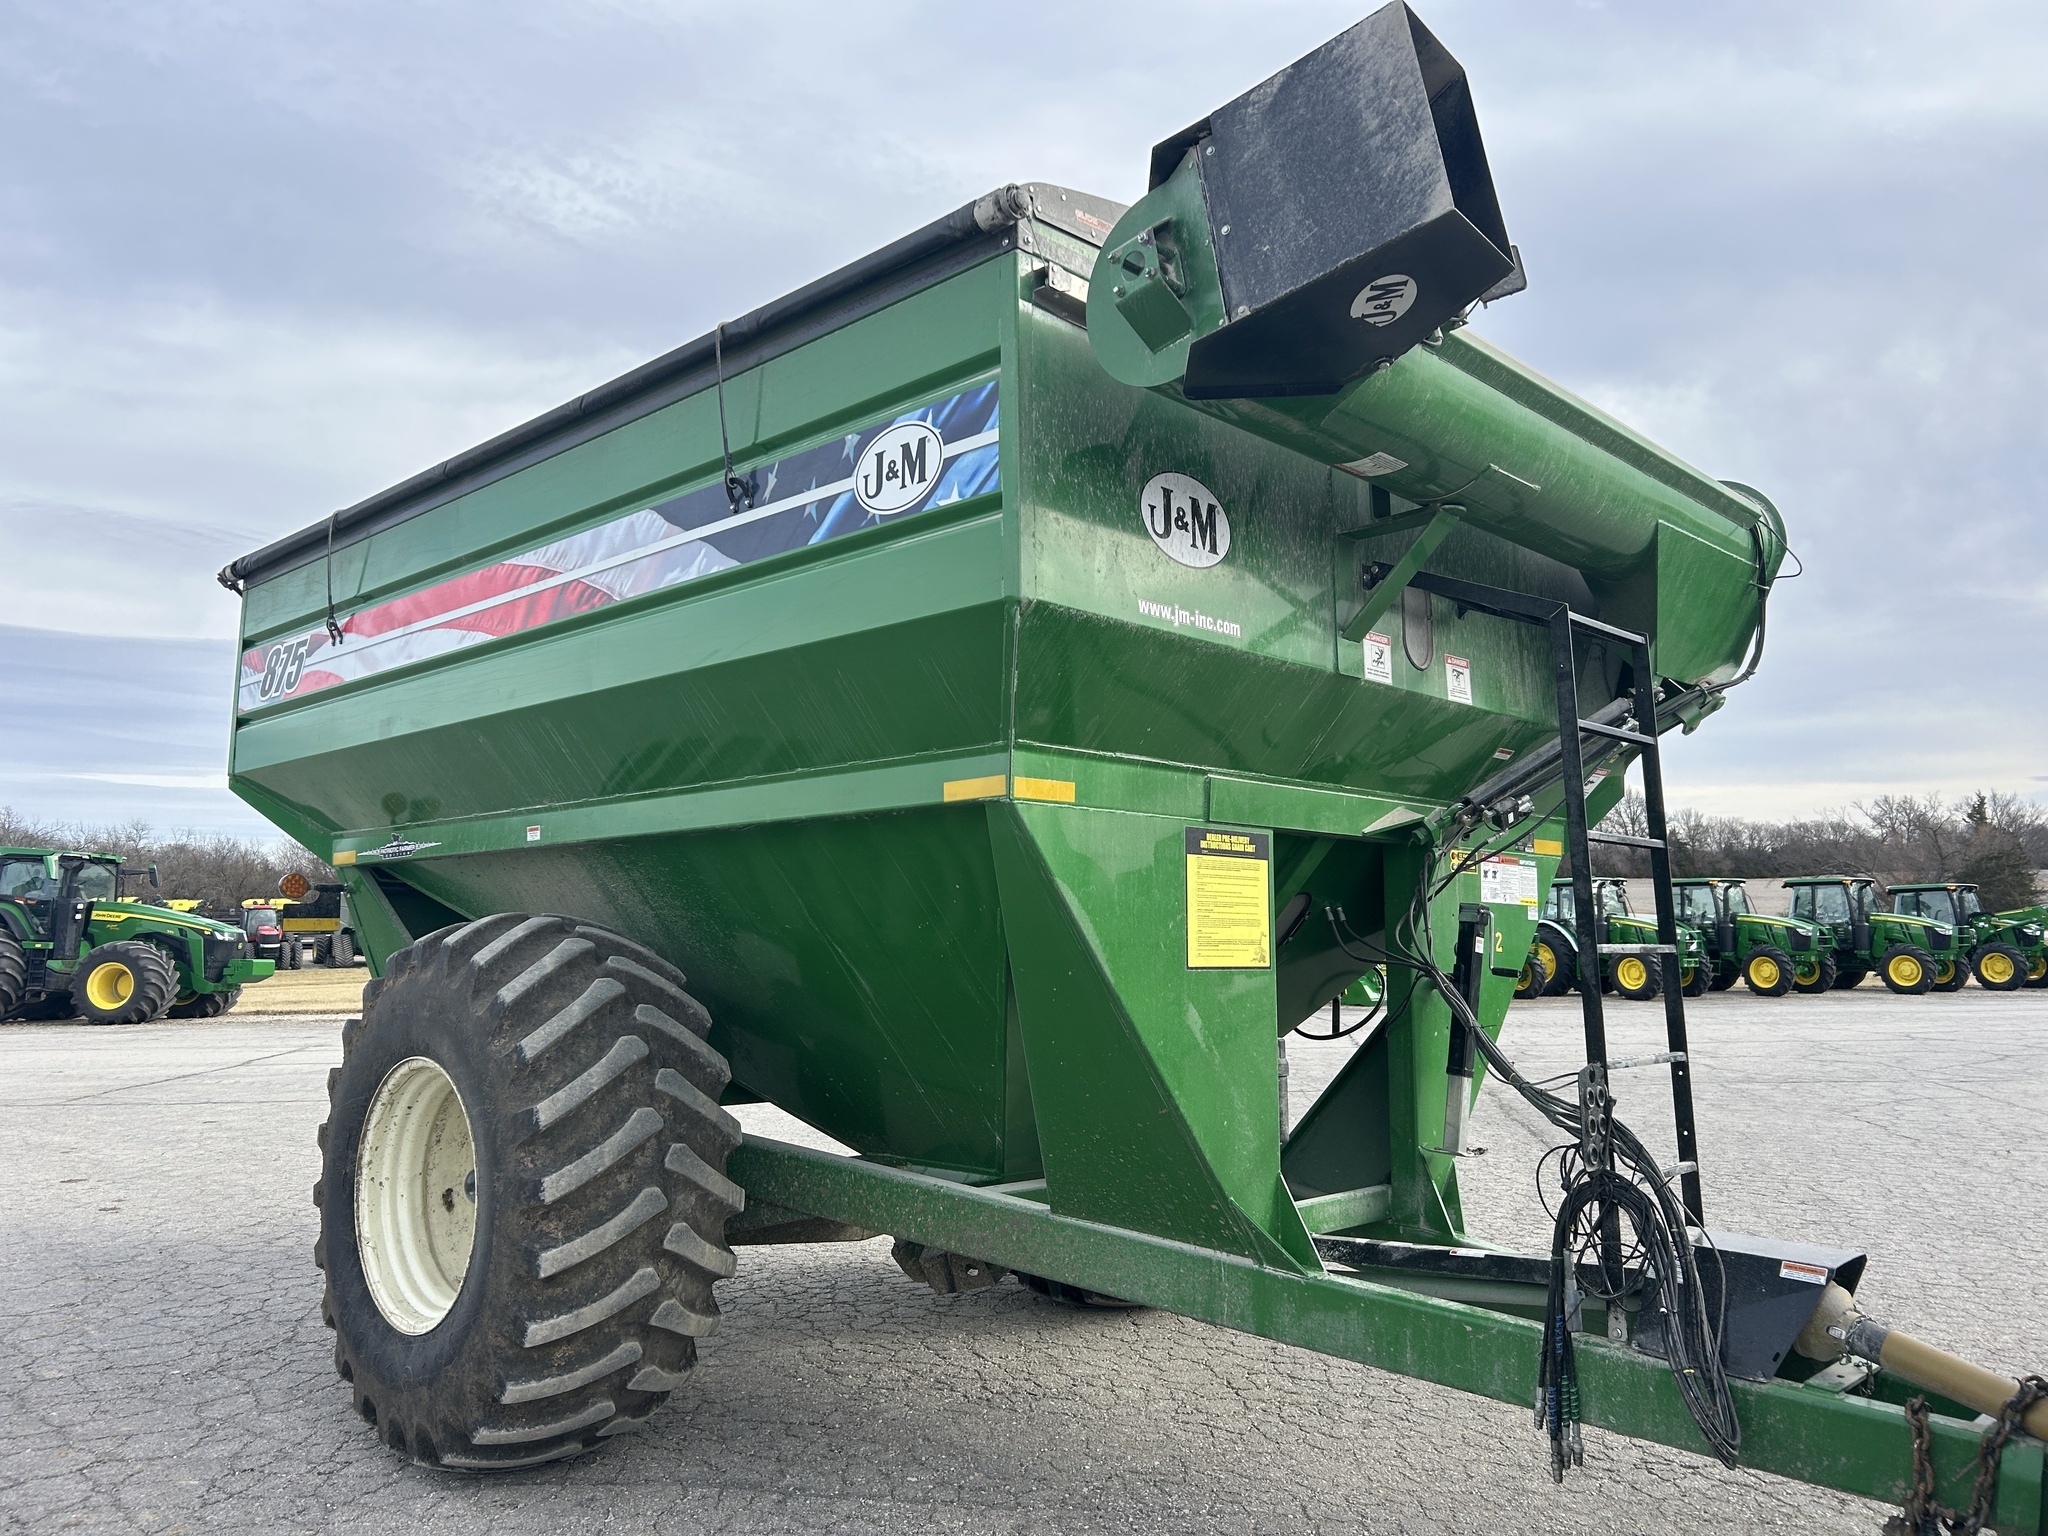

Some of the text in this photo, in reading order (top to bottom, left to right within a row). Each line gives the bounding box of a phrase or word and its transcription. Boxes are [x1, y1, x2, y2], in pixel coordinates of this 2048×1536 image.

[1361, 279, 1409, 325] J&M
[863, 435, 928, 500] J&M
[1148, 486, 1219, 556] J&M
[1138, 599, 1241, 638] www.jm-inc.com
[1370, 633, 1388, 644] DANGER
[260, 635, 311, 700] 875
[1451, 657, 1467, 667] DANGER
